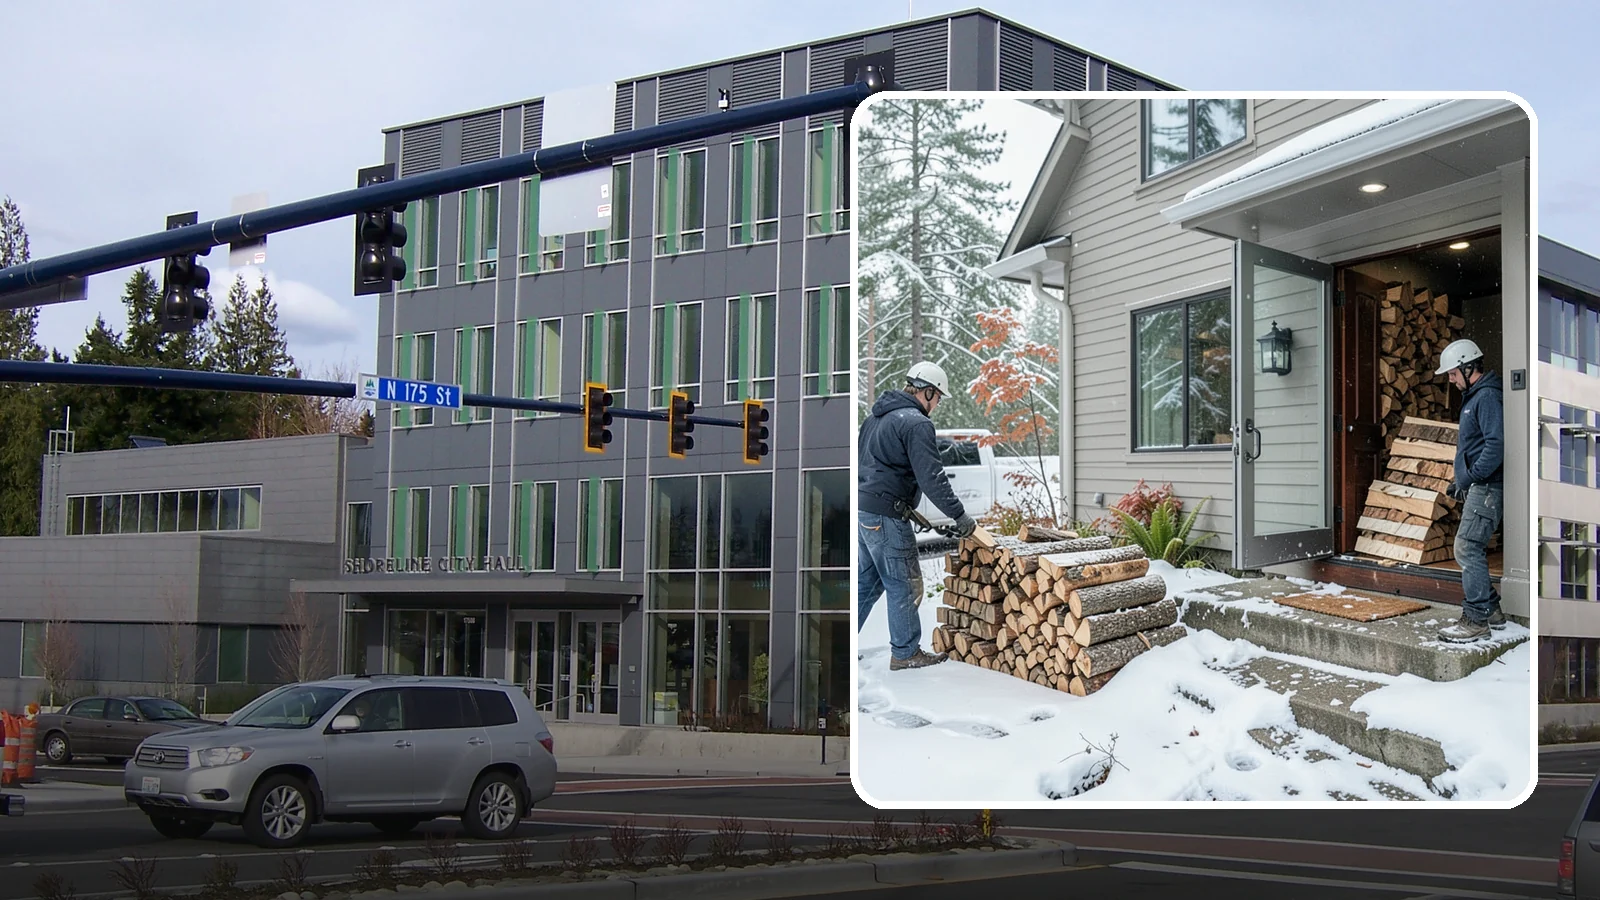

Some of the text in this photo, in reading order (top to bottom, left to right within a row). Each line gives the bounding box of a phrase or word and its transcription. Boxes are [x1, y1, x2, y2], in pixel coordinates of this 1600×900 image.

[387, 380, 451, 406] N 175 St
[344, 555, 526, 574] SHORELINE CITY HALL
